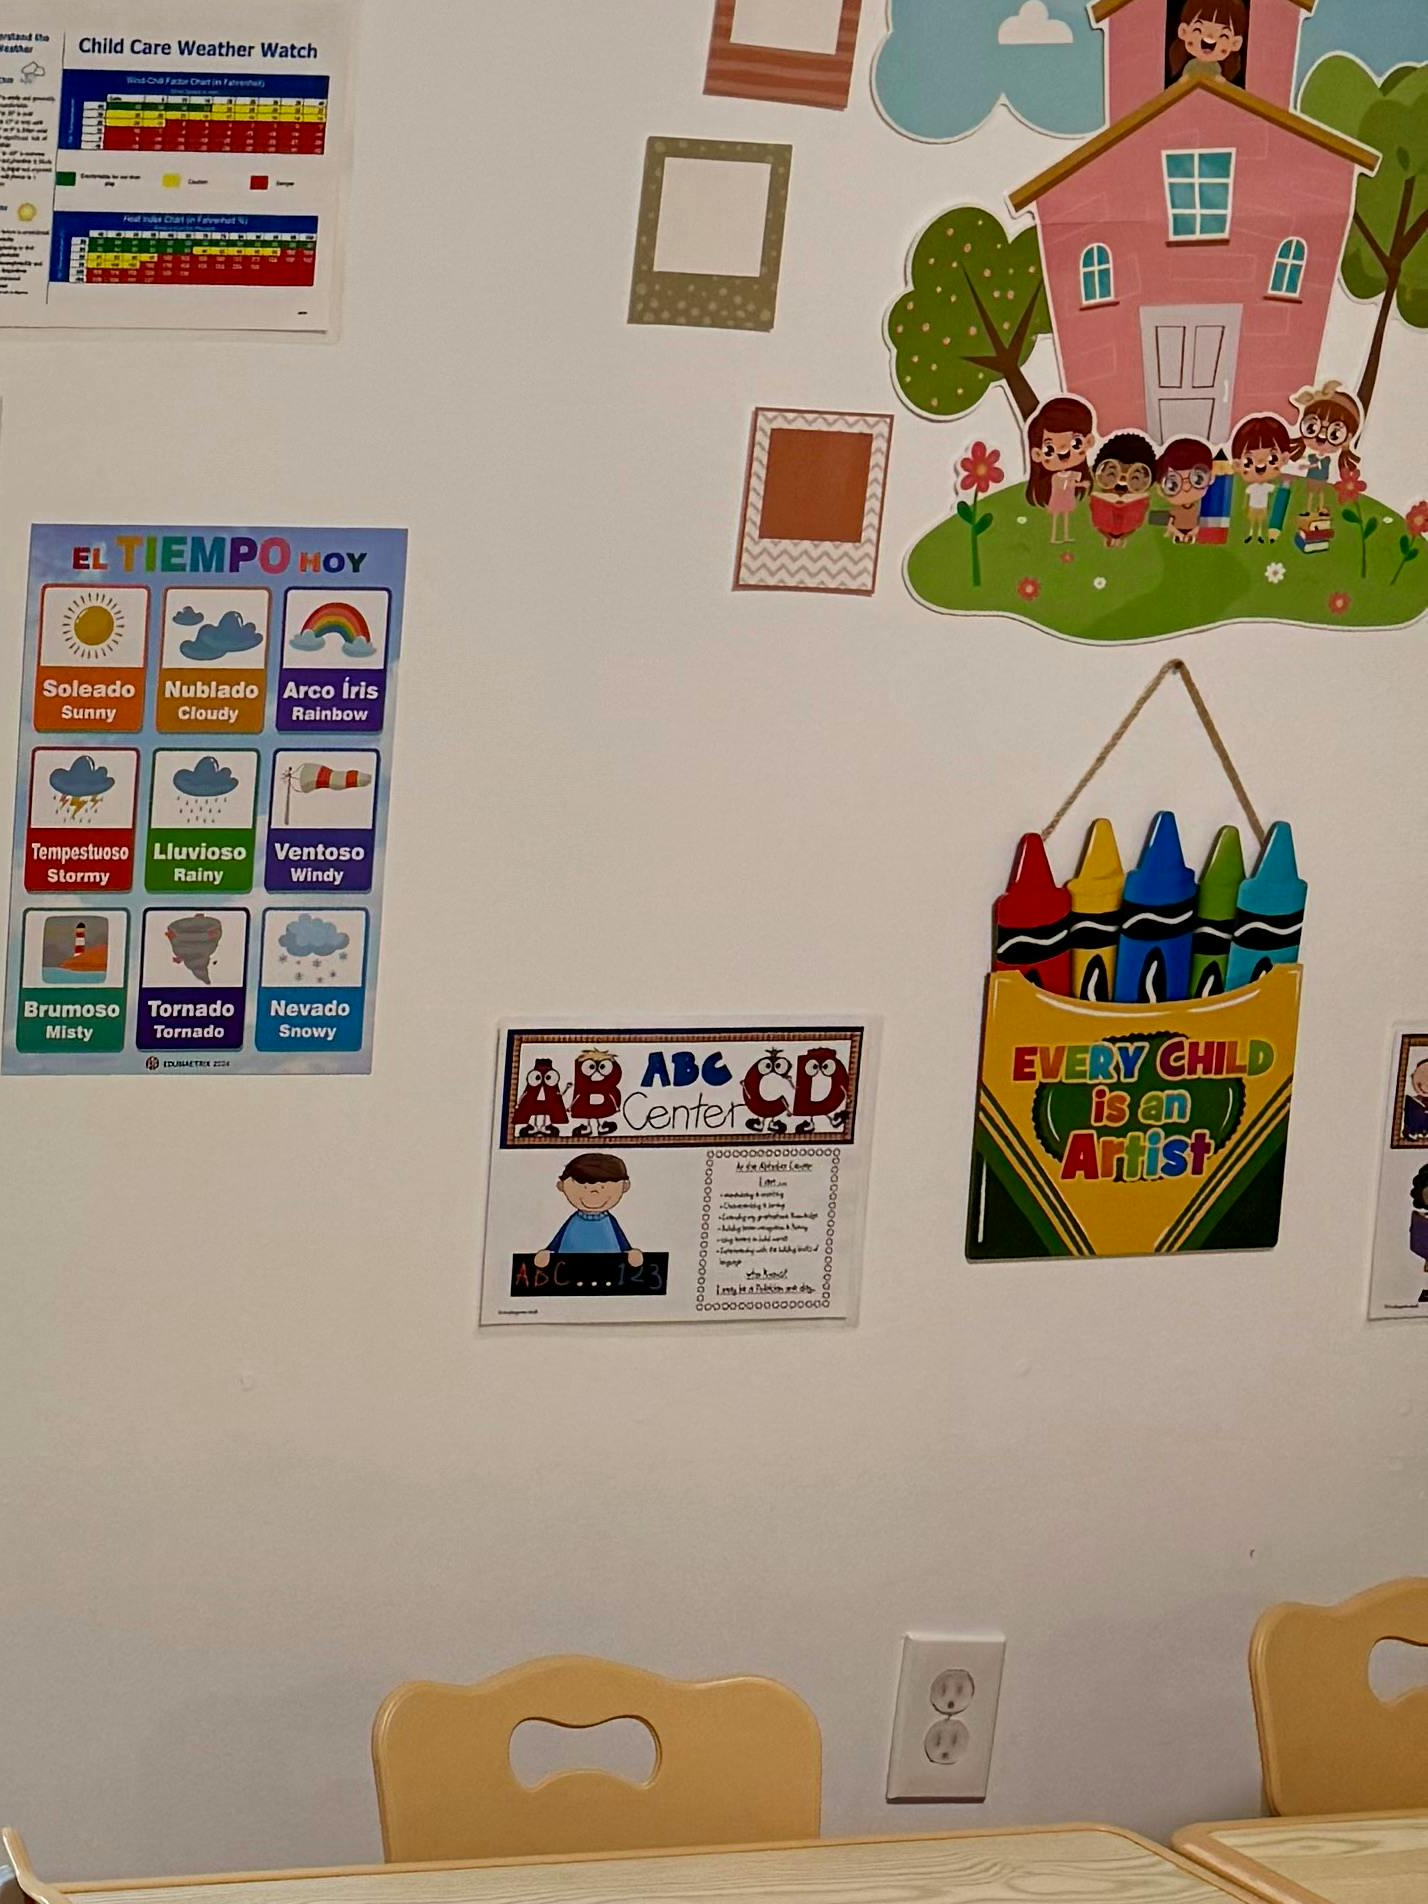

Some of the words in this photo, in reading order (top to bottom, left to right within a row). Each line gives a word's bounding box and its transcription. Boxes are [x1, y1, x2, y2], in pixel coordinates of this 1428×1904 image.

[78, 37, 125, 54] Child
[130, 39, 172, 55] Care
[177, 40, 255, 58] Weather
[261, 42, 318, 59] Watch
[72, 546, 109, 571] EL
[114, 535, 291, 575] TIEMPO
[299, 551, 368, 574] HOY
[43, 679, 136, 699] Soleado
[165, 679, 259, 699] Nublado
[283, 681, 335, 699] Arco
[342, 676, 379, 699] Íris
[61, 705, 117, 723] Sunny
[178, 706, 239, 724] Cloudy
[291, 706, 368, 722] Rainbow
[31, 842, 130, 863] Tempestuoso
[153, 842, 247, 861] Lluvioso
[274, 843, 365, 861] Ventoso
[47, 869, 110, 886] Stormy
[174, 867, 224, 885] Rainy
[291, 867, 344, 885] Windy
[24, 1000, 121, 1019] Brumoso
[148, 1000, 235, 1018] Tornado
[270, 1000, 350, 1018] Nevado
[46, 1025, 94, 1042] Misty
[154, 1025, 225, 1039] Tornado
[279, 1024, 337, 1041] Snowy
[641, 1051, 733, 1088] ABC
[1012, 1045, 1146, 1084] EVERY
[1157, 1038, 1275, 1079] CHILD
[622, 1092, 746, 1131] Center
[1091, 1087, 1127, 1126] is
[1142, 1089, 1188, 1125] an
[1060, 1129, 1214, 1181] Artist
